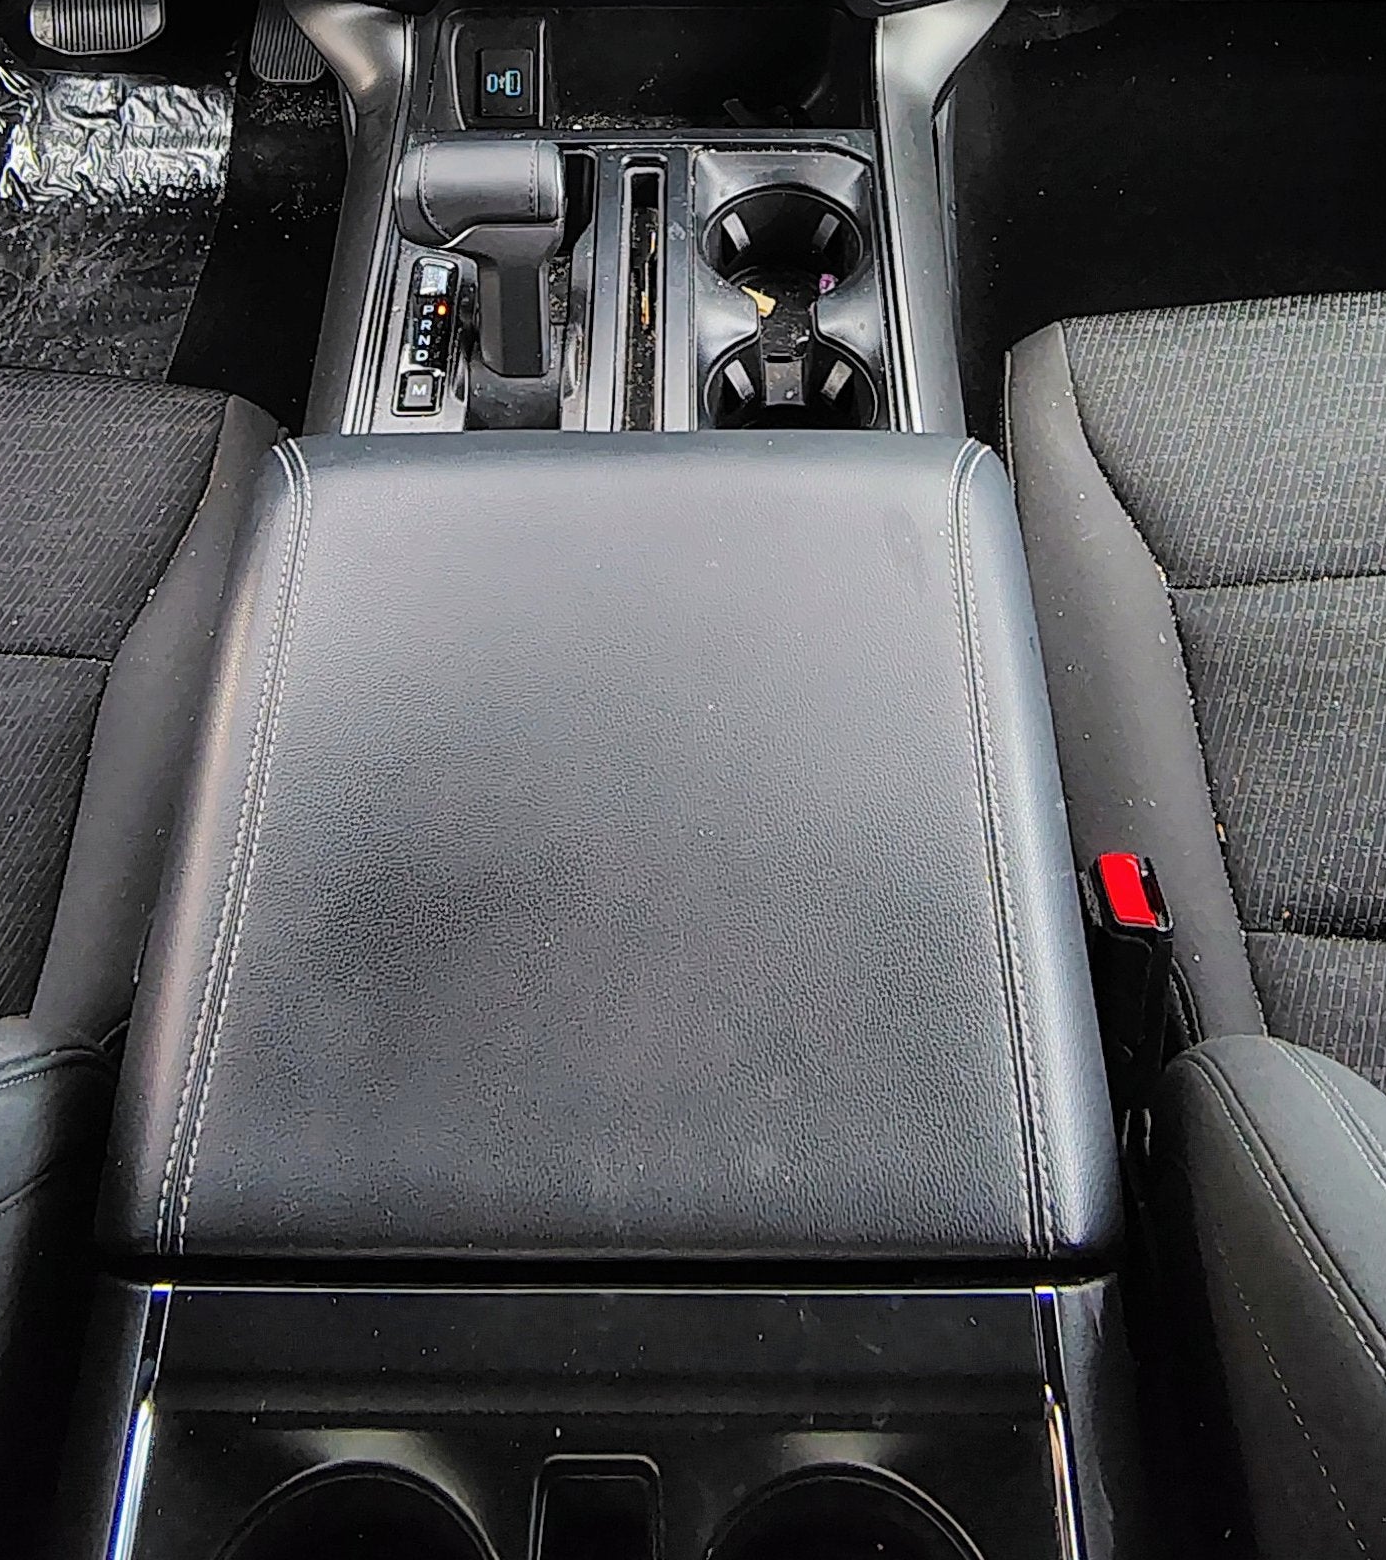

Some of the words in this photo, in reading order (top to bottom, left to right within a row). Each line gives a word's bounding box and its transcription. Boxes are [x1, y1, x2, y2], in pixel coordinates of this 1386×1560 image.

[422, 304, 434, 316] P
[420, 319, 432, 331] R
[418, 334, 431, 346] N
[415, 349, 429, 362] D
[412, 383, 427, 396] M
